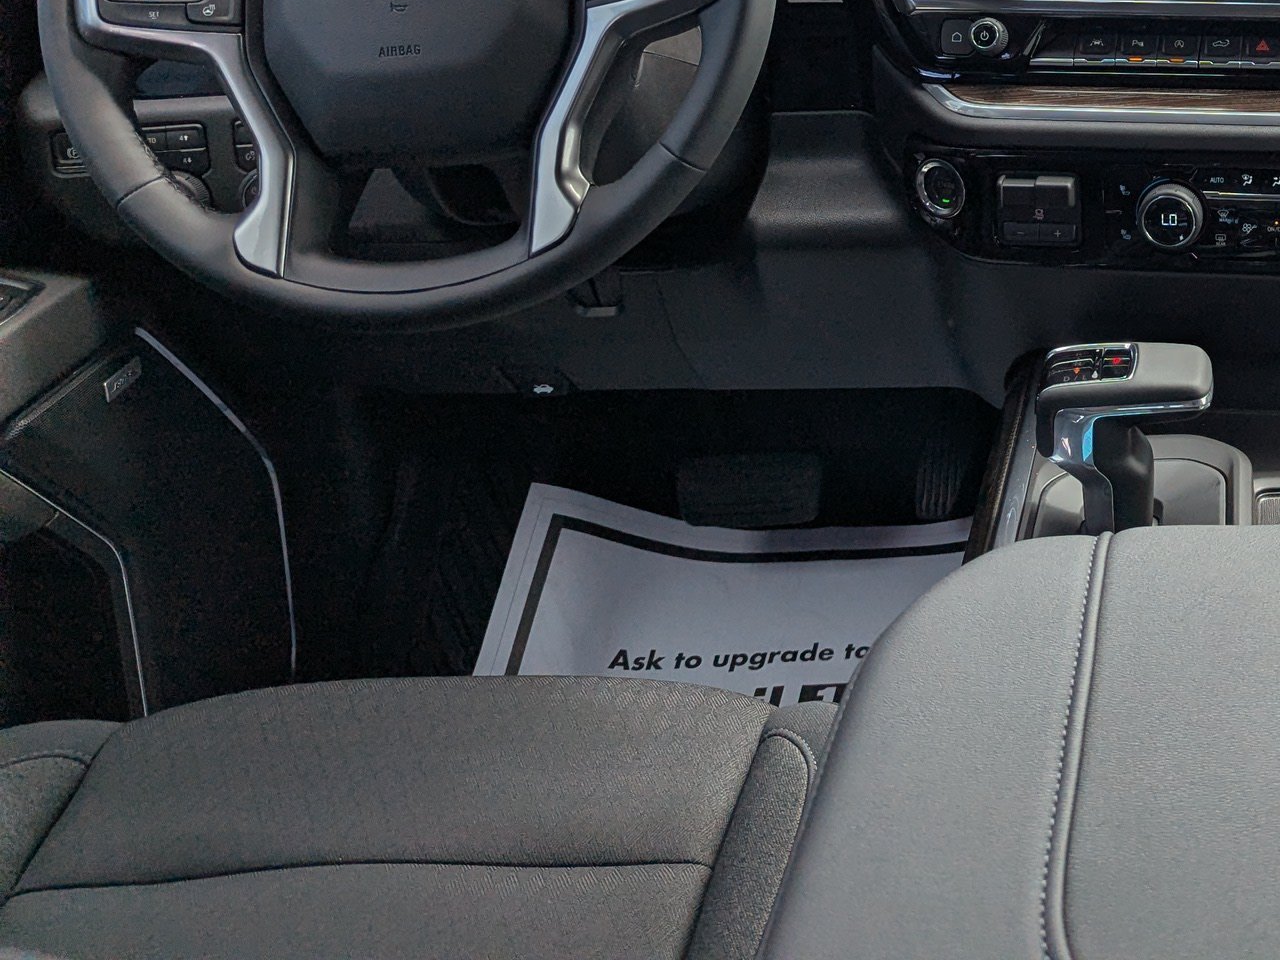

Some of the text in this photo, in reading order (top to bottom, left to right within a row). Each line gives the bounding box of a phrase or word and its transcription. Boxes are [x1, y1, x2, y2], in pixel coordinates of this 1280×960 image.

[379, 44, 421, 57] AIRBAG
[608, 642, 871, 672] Ask to upgrade to
